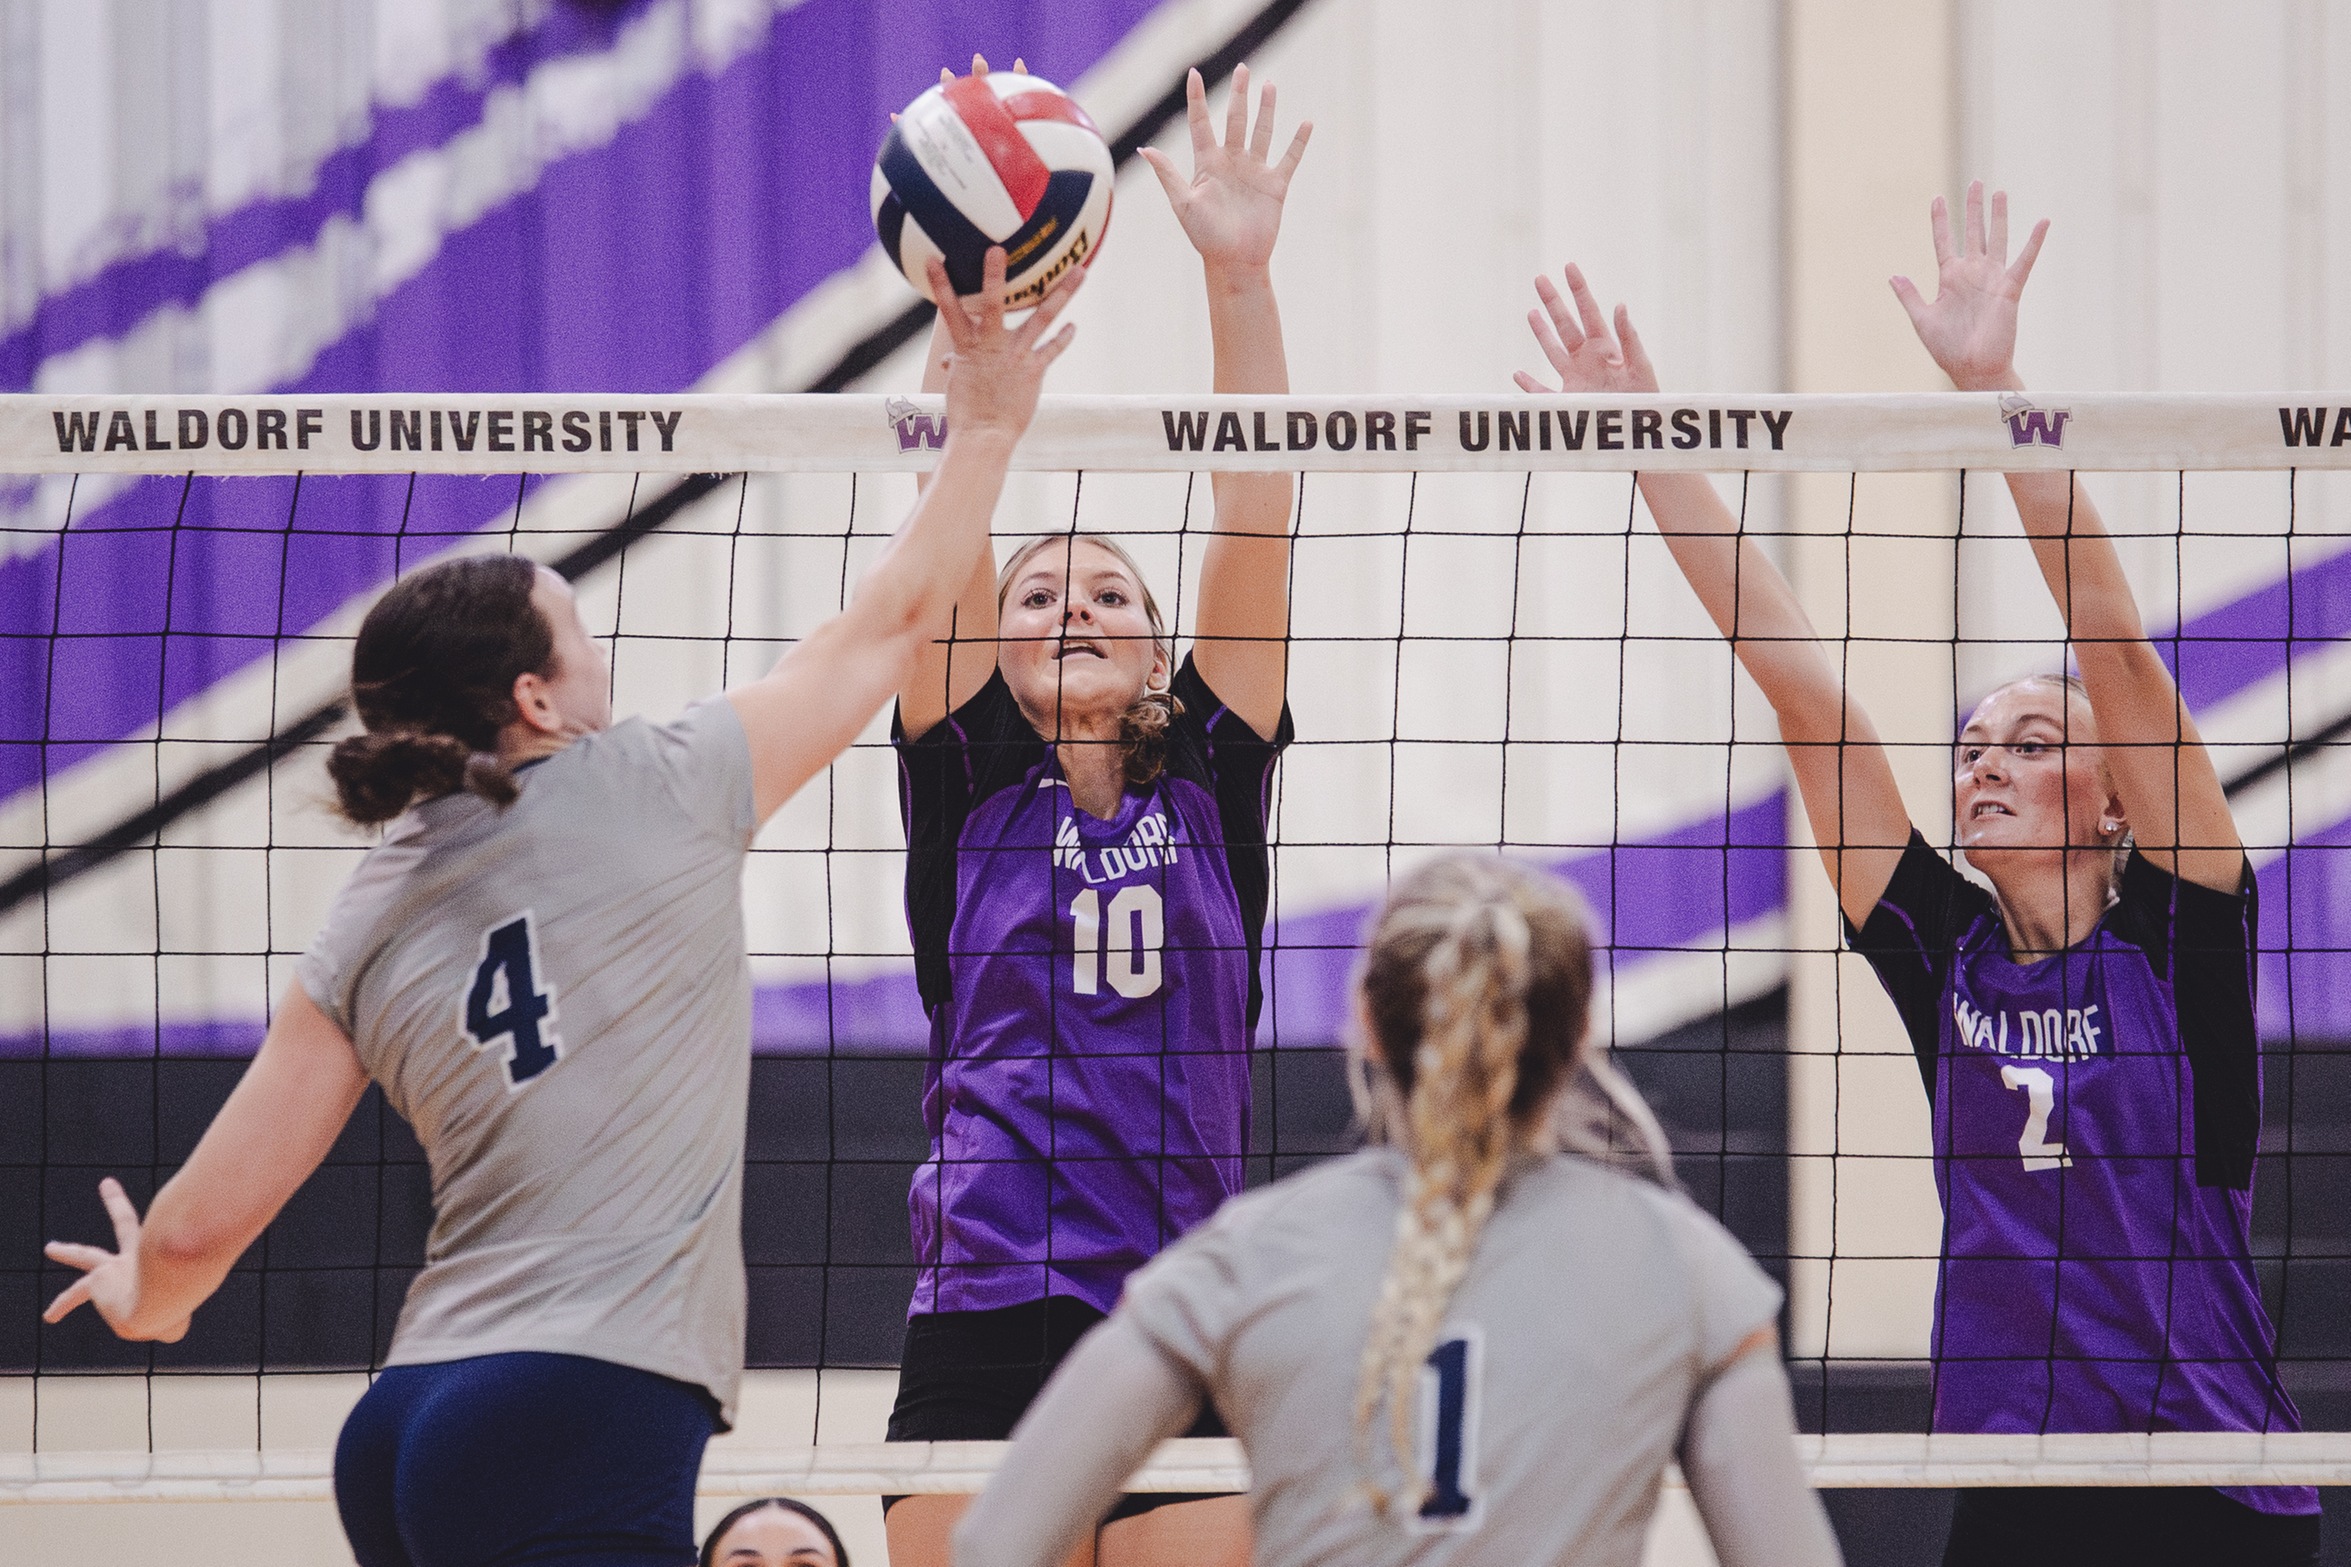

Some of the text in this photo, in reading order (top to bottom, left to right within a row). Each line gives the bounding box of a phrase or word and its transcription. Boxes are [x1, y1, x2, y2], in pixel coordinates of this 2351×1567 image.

[53, 409, 683, 453] WALDORF UNIVERSITY
[1162, 409, 1793, 452] WALDORF UNIVERSITY
[2005, 407, 2072, 450] W
[1053, 812, 1179, 884] WLDORF
[1069, 884, 1165, 998] 10
[458, 909, 565, 1094] 4
[1953, 991, 2101, 1063] WALDORF
[2000, 1064, 2074, 1172] 2
[1410, 1329, 1481, 1528] 1
